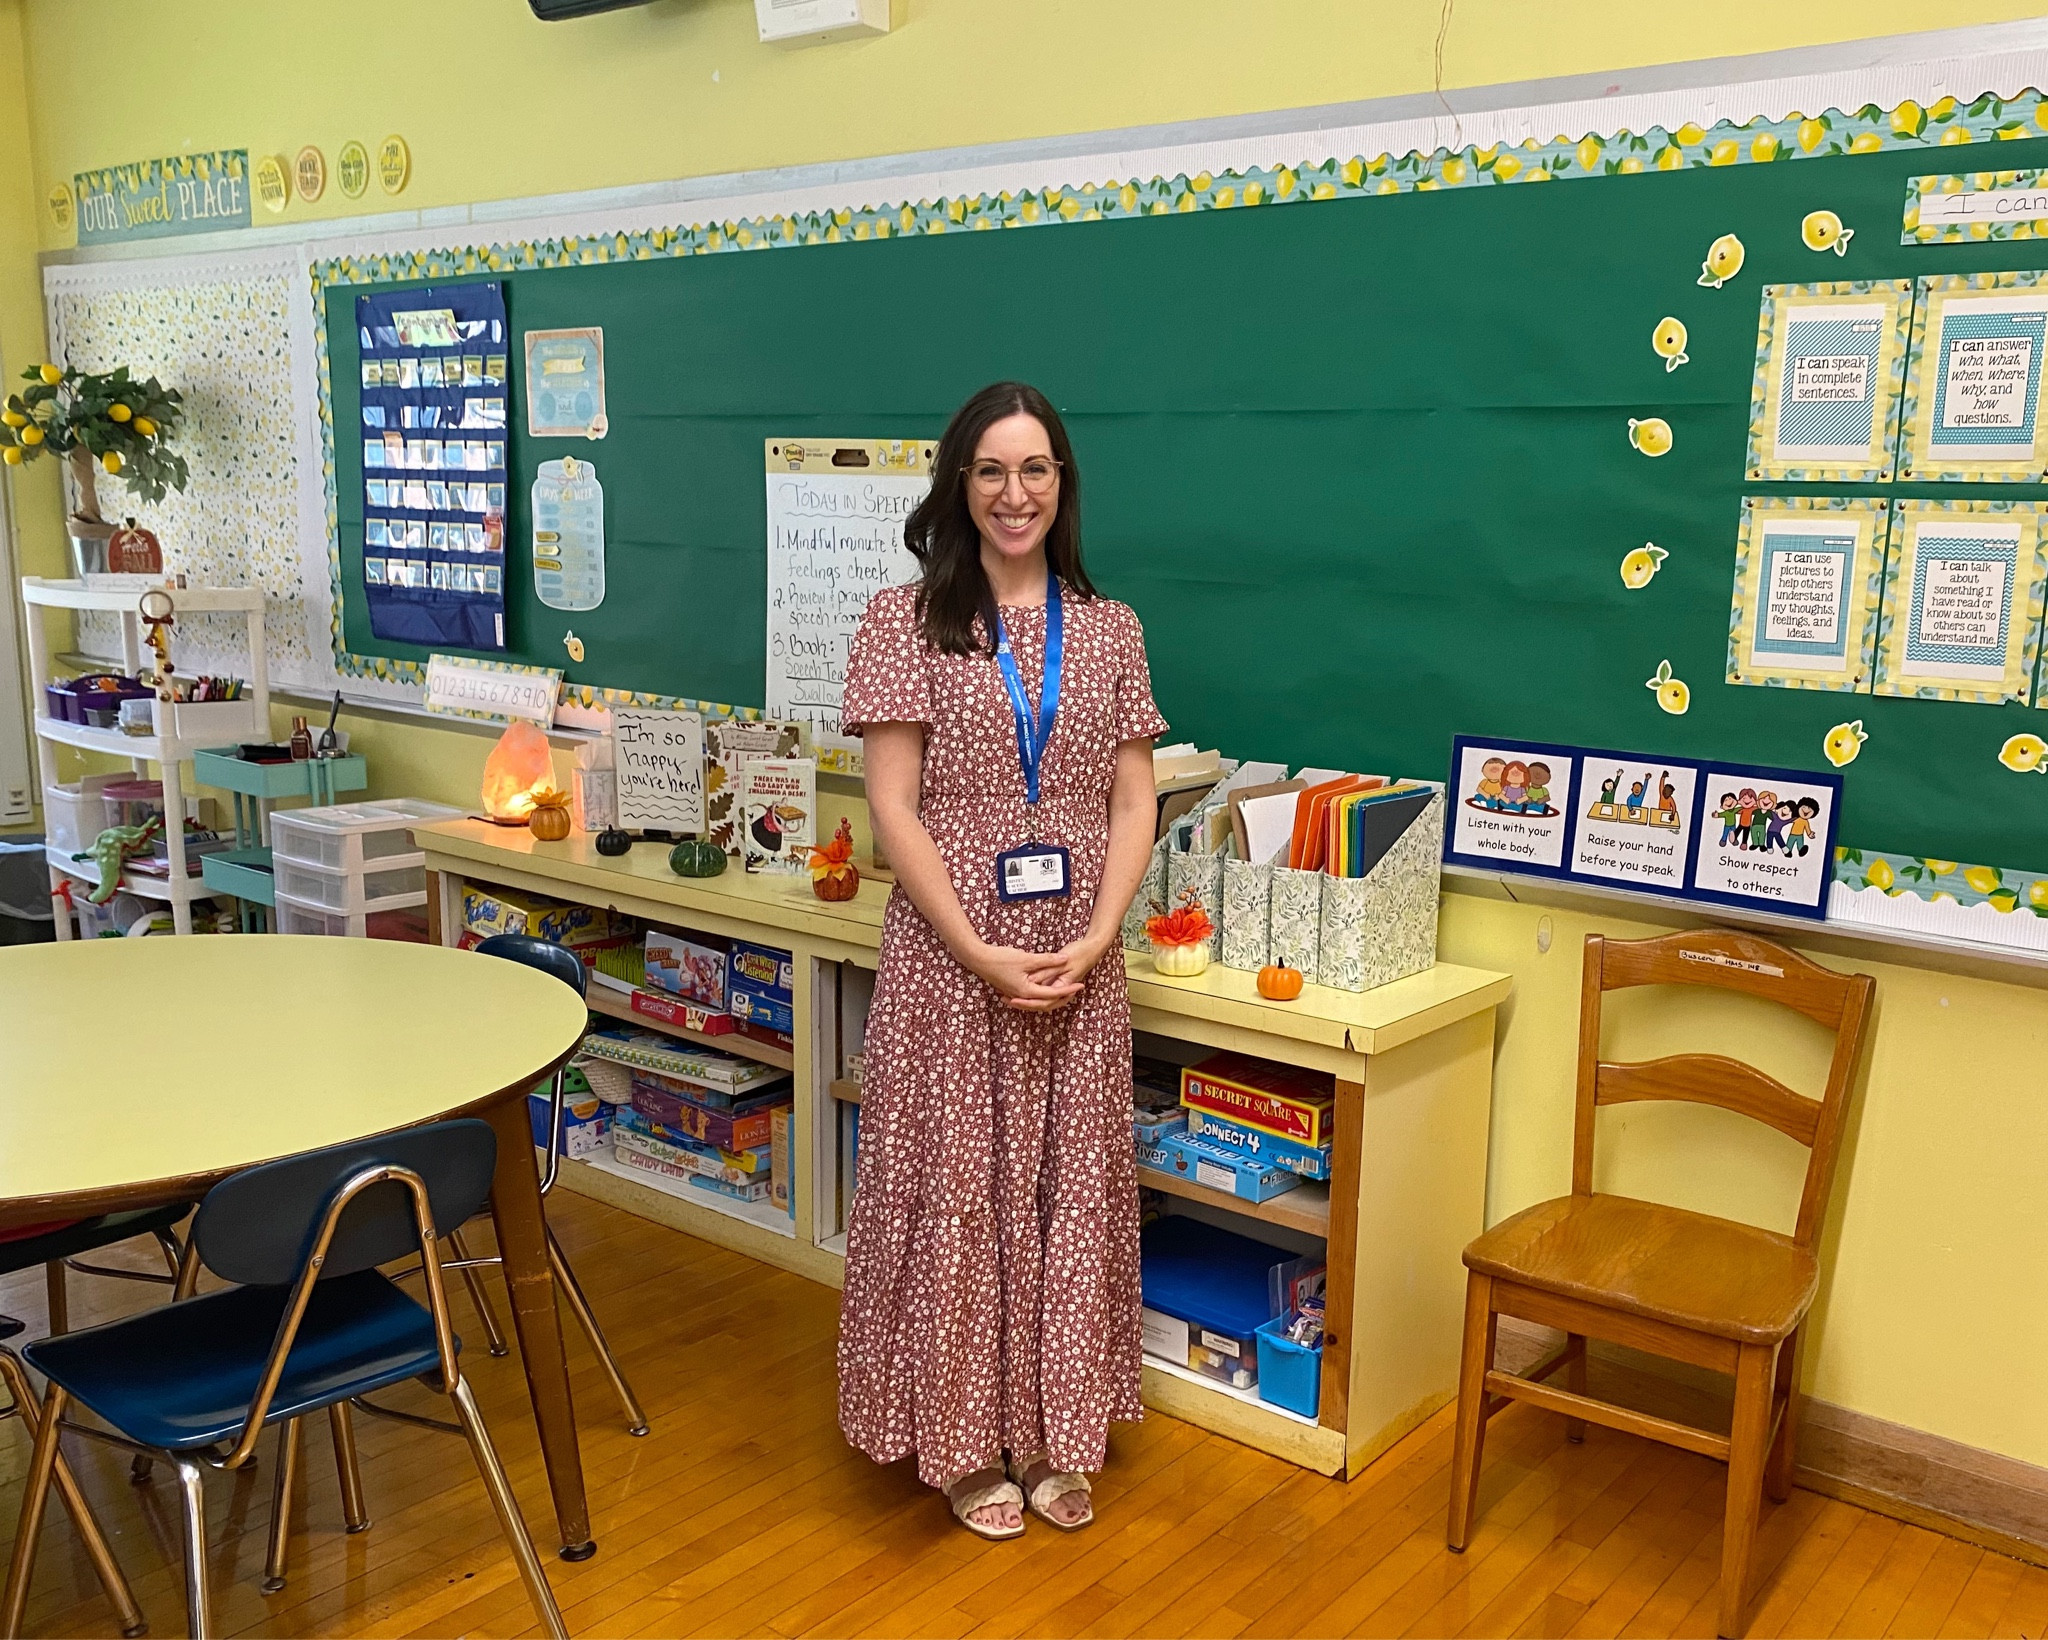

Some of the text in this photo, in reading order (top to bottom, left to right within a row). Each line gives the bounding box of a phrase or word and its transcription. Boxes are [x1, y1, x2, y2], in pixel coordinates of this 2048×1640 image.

[83, 176, 242, 232] OUR Sweet PLACE
[1943, 194, 2048, 214] I can
[1951, 340, 2032, 352] I can answer
[1797, 356, 1866, 371] I can speak
[1959, 354, 2020, 367] who, what,
[1798, 372, 1862, 386] in complete
[1951, 369, 2026, 381] when, where,
[1798, 387, 1858, 399] sentences.
[1961, 383, 2012, 398] why, and
[1973, 398, 1999, 410] how
[1954, 413, 2012, 427] questions.
[788, 526, 836, 553] Mindful
[841, 529, 886, 553] minute
[1785, 552, 1832, 564] I can use
[788, 553, 841, 588] feelings
[1780, 566, 1834, 576] pictures to
[1940, 561, 1992, 572] I can talk
[1778, 578, 1833, 590] help others
[1949, 574, 1980, 584] about
[1776, 590, 1834, 602] understand
[1934, 585, 1993, 597] something I
[1772, 603, 1835, 616] my thoughts,
[1931, 597, 1993, 608] have read or
[789, 608, 830, 630] speech
[1926, 607, 1996, 621] know about so
[1772, 615, 1832, 628] feelings, and
[1934, 620, 1985, 632] others can
[1787, 628, 1815, 639] ideas.
[1921, 631, 1996, 645] understand me.
[789, 634, 834, 658] Book:
[785, 656, 846, 682] Speech Tea
[618, 724, 686, 746] I'm so
[624, 746, 688, 776] happy
[621, 772, 665, 794] you're
[1468, 817, 1552, 838] Listen with your
[1478, 838, 1537, 857] whole body.
[1588, 834, 1674, 856] Raise your hand
[1580, 852, 1676, 877] before you speak.
[1719, 856, 1799, 878] Show respect
[1727, 878, 1785, 896] to others.
[1204, 1084, 1252, 1109] SECRET
[1247, 1132, 1260, 1154] 4
